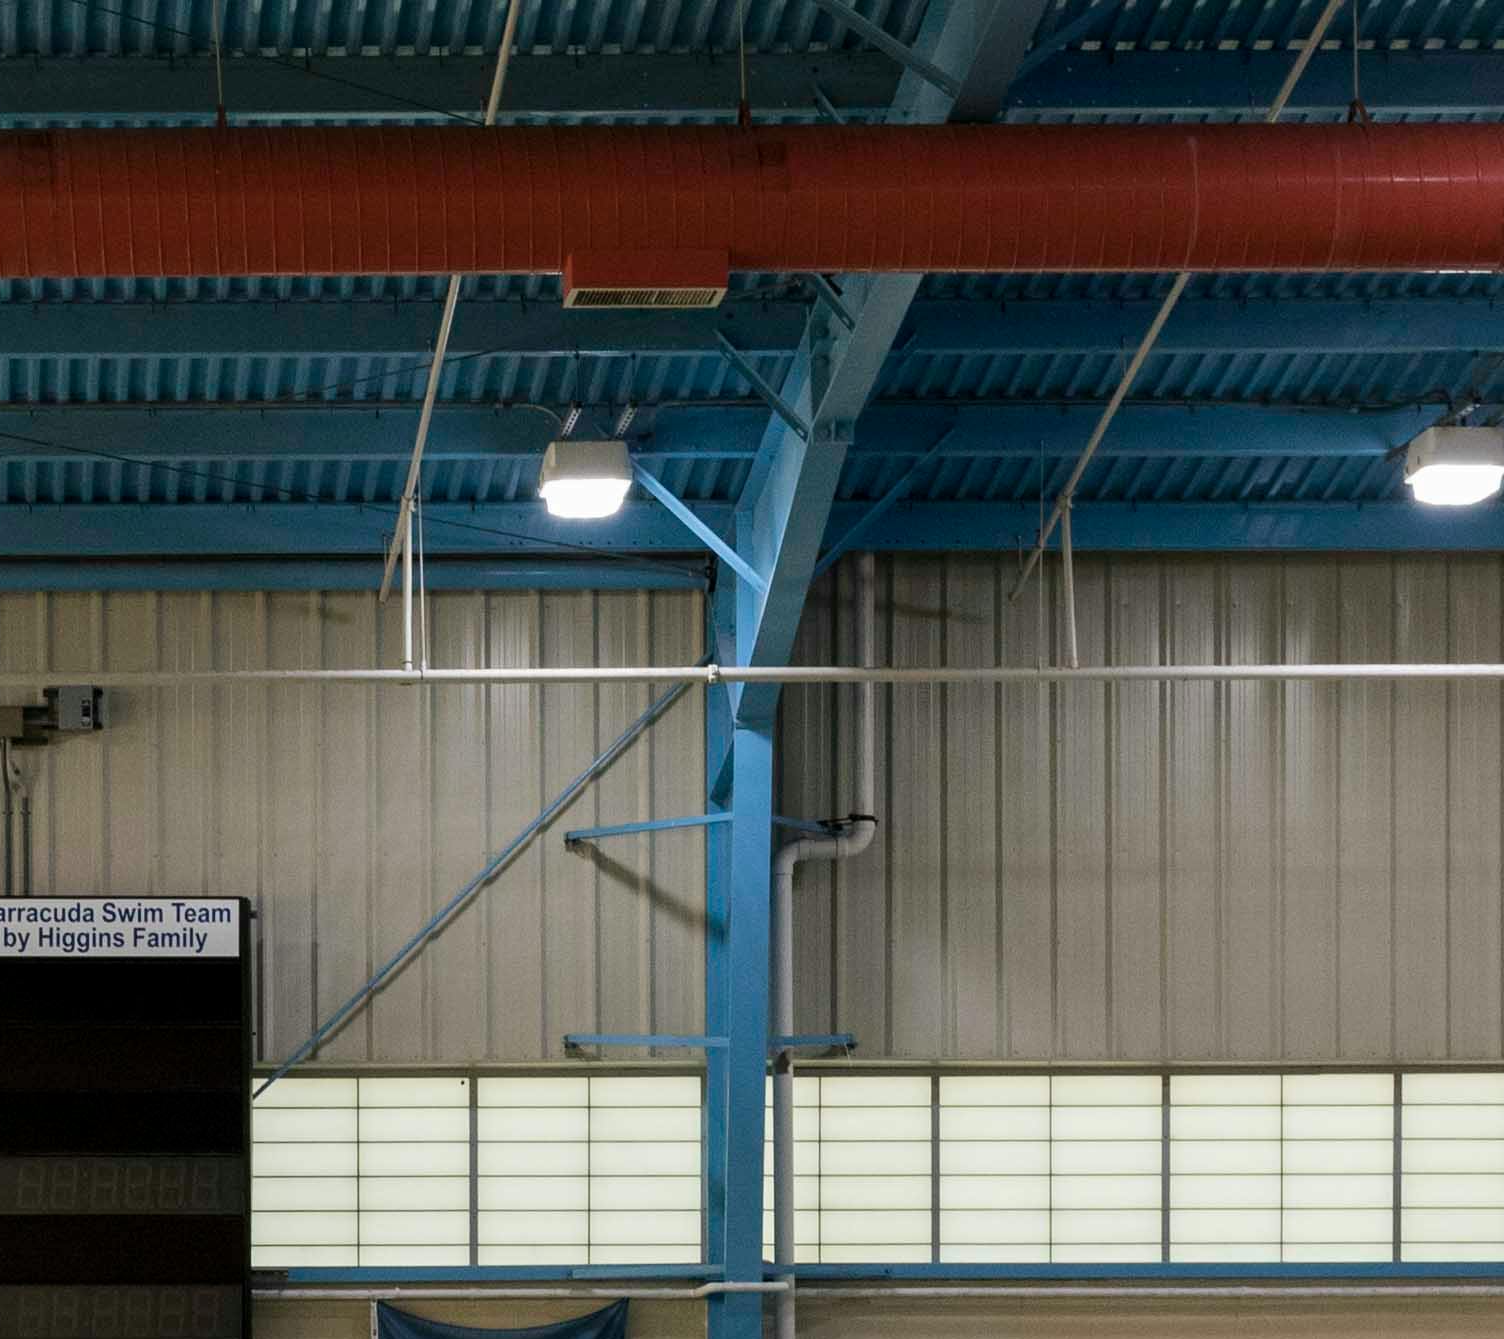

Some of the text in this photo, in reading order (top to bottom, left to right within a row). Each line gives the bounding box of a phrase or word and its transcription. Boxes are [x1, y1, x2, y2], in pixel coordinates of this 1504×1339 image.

[102, 902, 164, 923] Swim
[172, 902, 231, 923] Team
[3, 927, 30, 953] by
[38, 927, 125, 953] Higgins
[133, 927, 208, 953] Family
